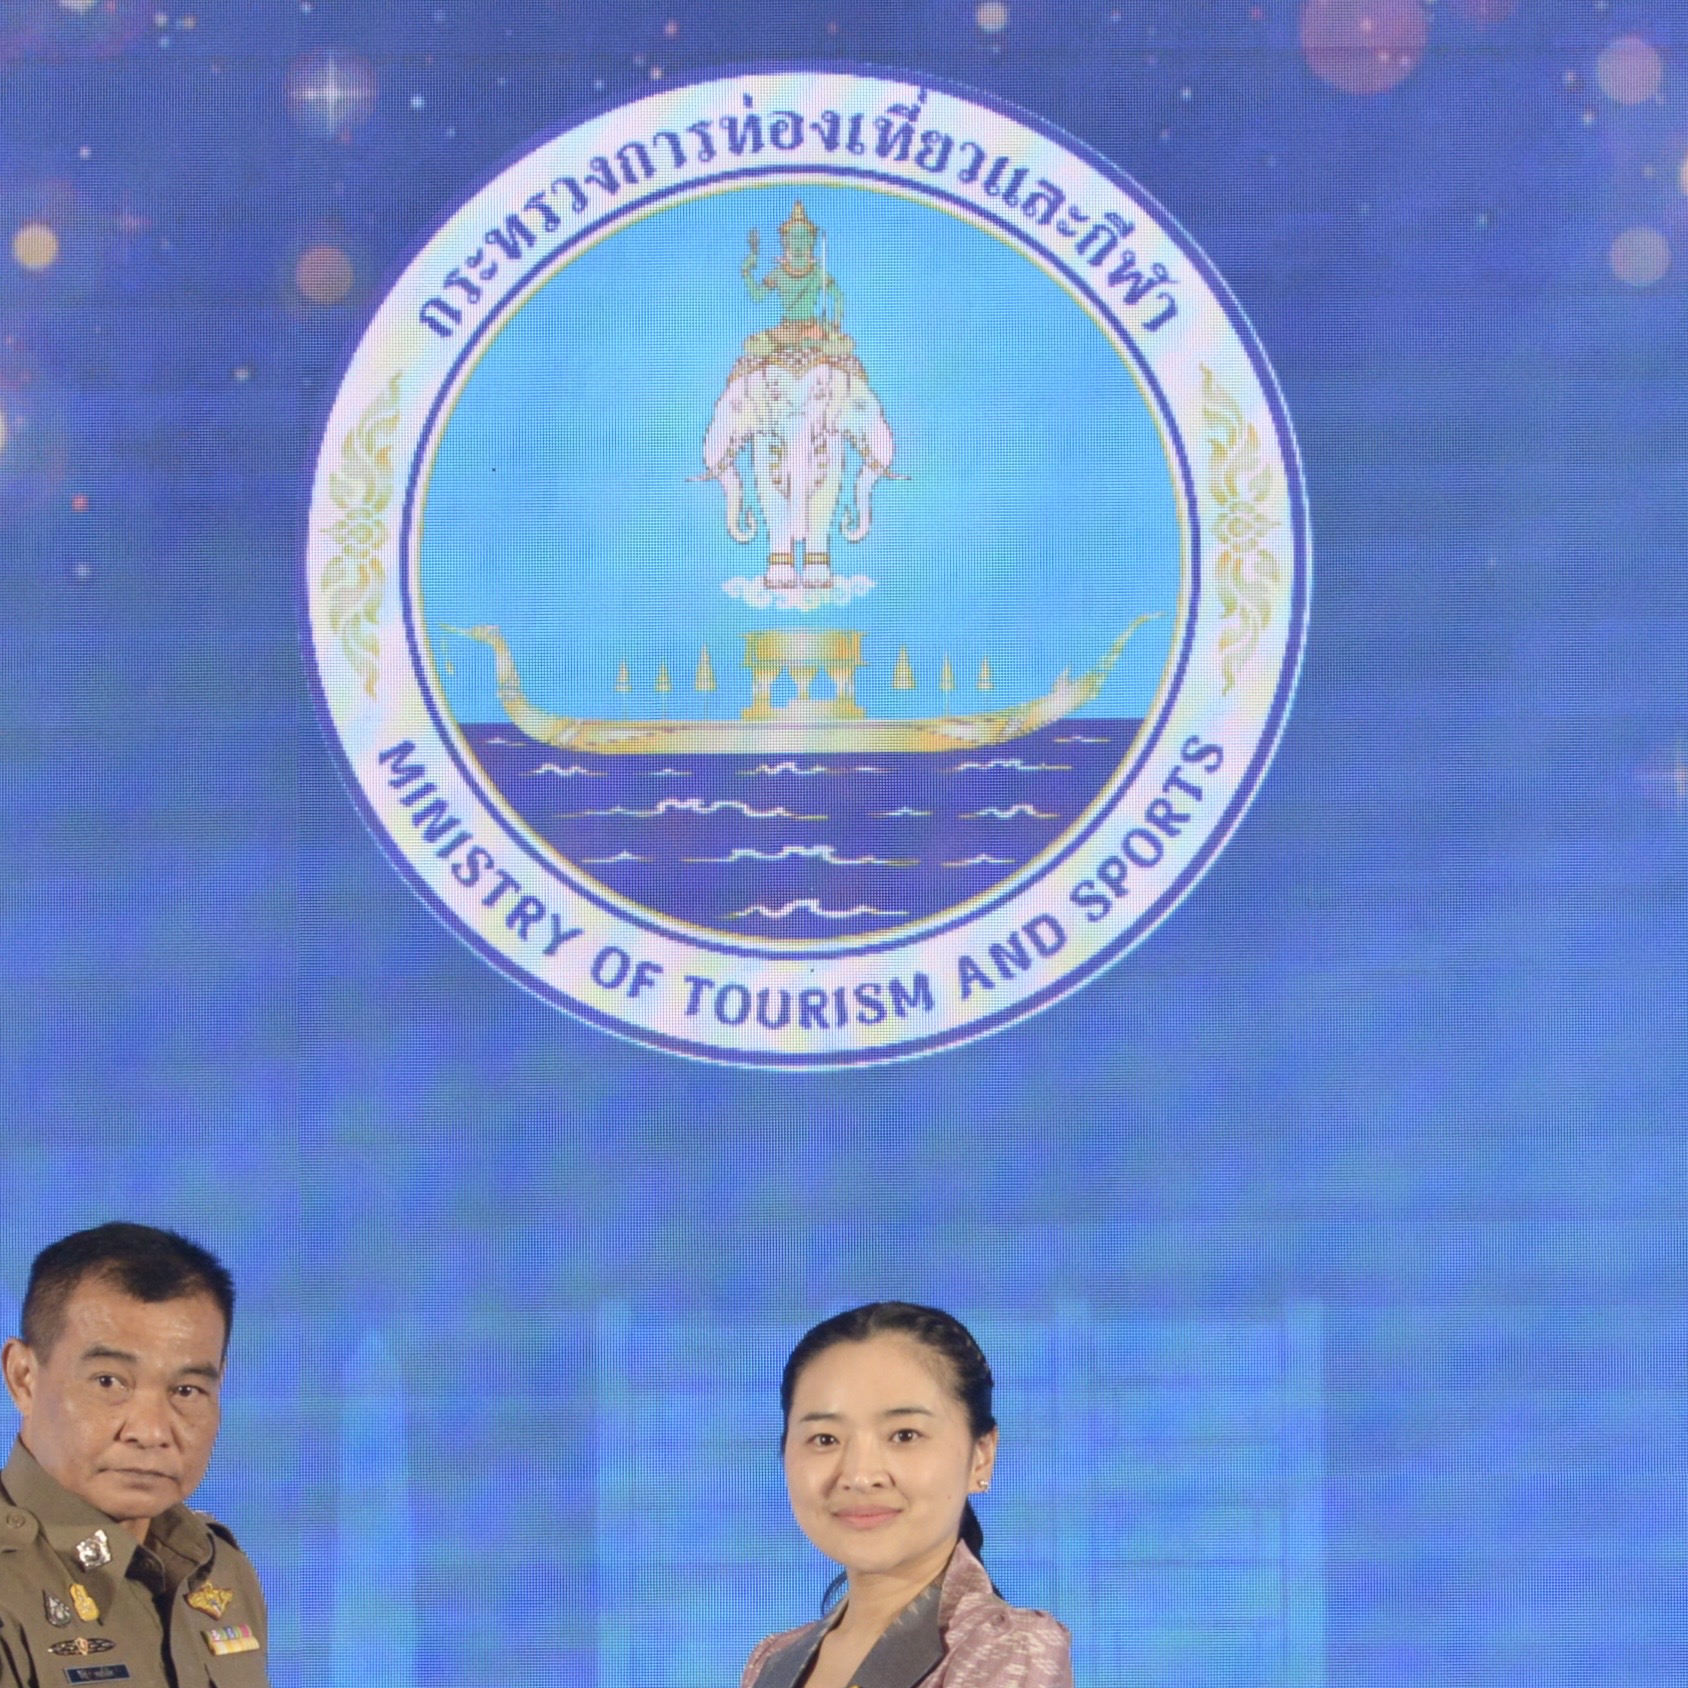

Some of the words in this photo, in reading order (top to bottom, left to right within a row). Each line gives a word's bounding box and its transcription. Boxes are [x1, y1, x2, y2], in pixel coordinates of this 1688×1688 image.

[418, 87, 1179, 338] กระทรวงการท่องเที่ยวและกีฬา
[378, 740, 584, 957] MINISTRY
[590, 945, 664, 999] OF
[682, 971, 936, 1031] TOURISM
[957, 913, 1069, 1001] AND
[1069, 735, 1224, 924] SPORTS
